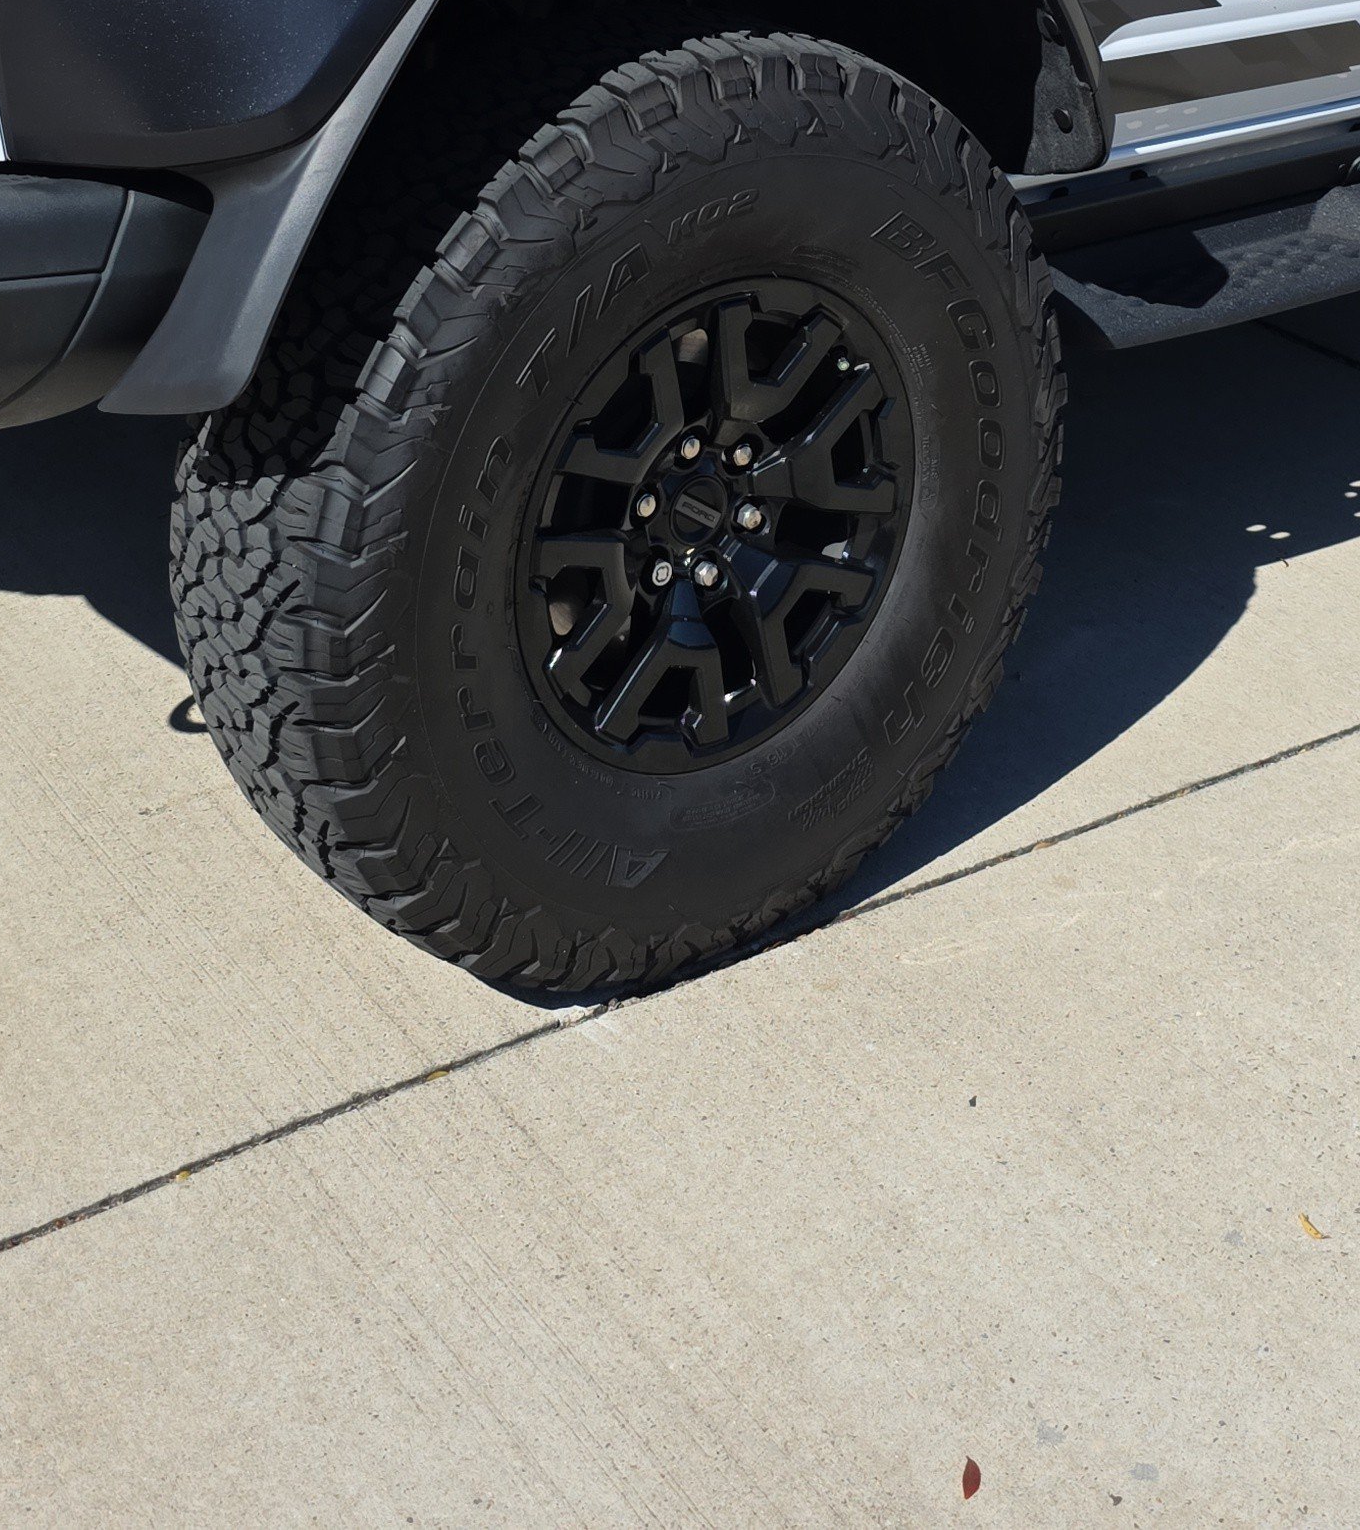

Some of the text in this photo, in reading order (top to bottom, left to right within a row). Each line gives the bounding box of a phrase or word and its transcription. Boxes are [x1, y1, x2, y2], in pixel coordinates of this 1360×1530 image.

[666, 188, 761, 246] KO2
[515, 242, 652, 399] T/A
[682, 501, 715, 522] FORD
[869, 209, 1008, 746] BFGoodrich
[449, 433, 670, 889] All-Terrain
